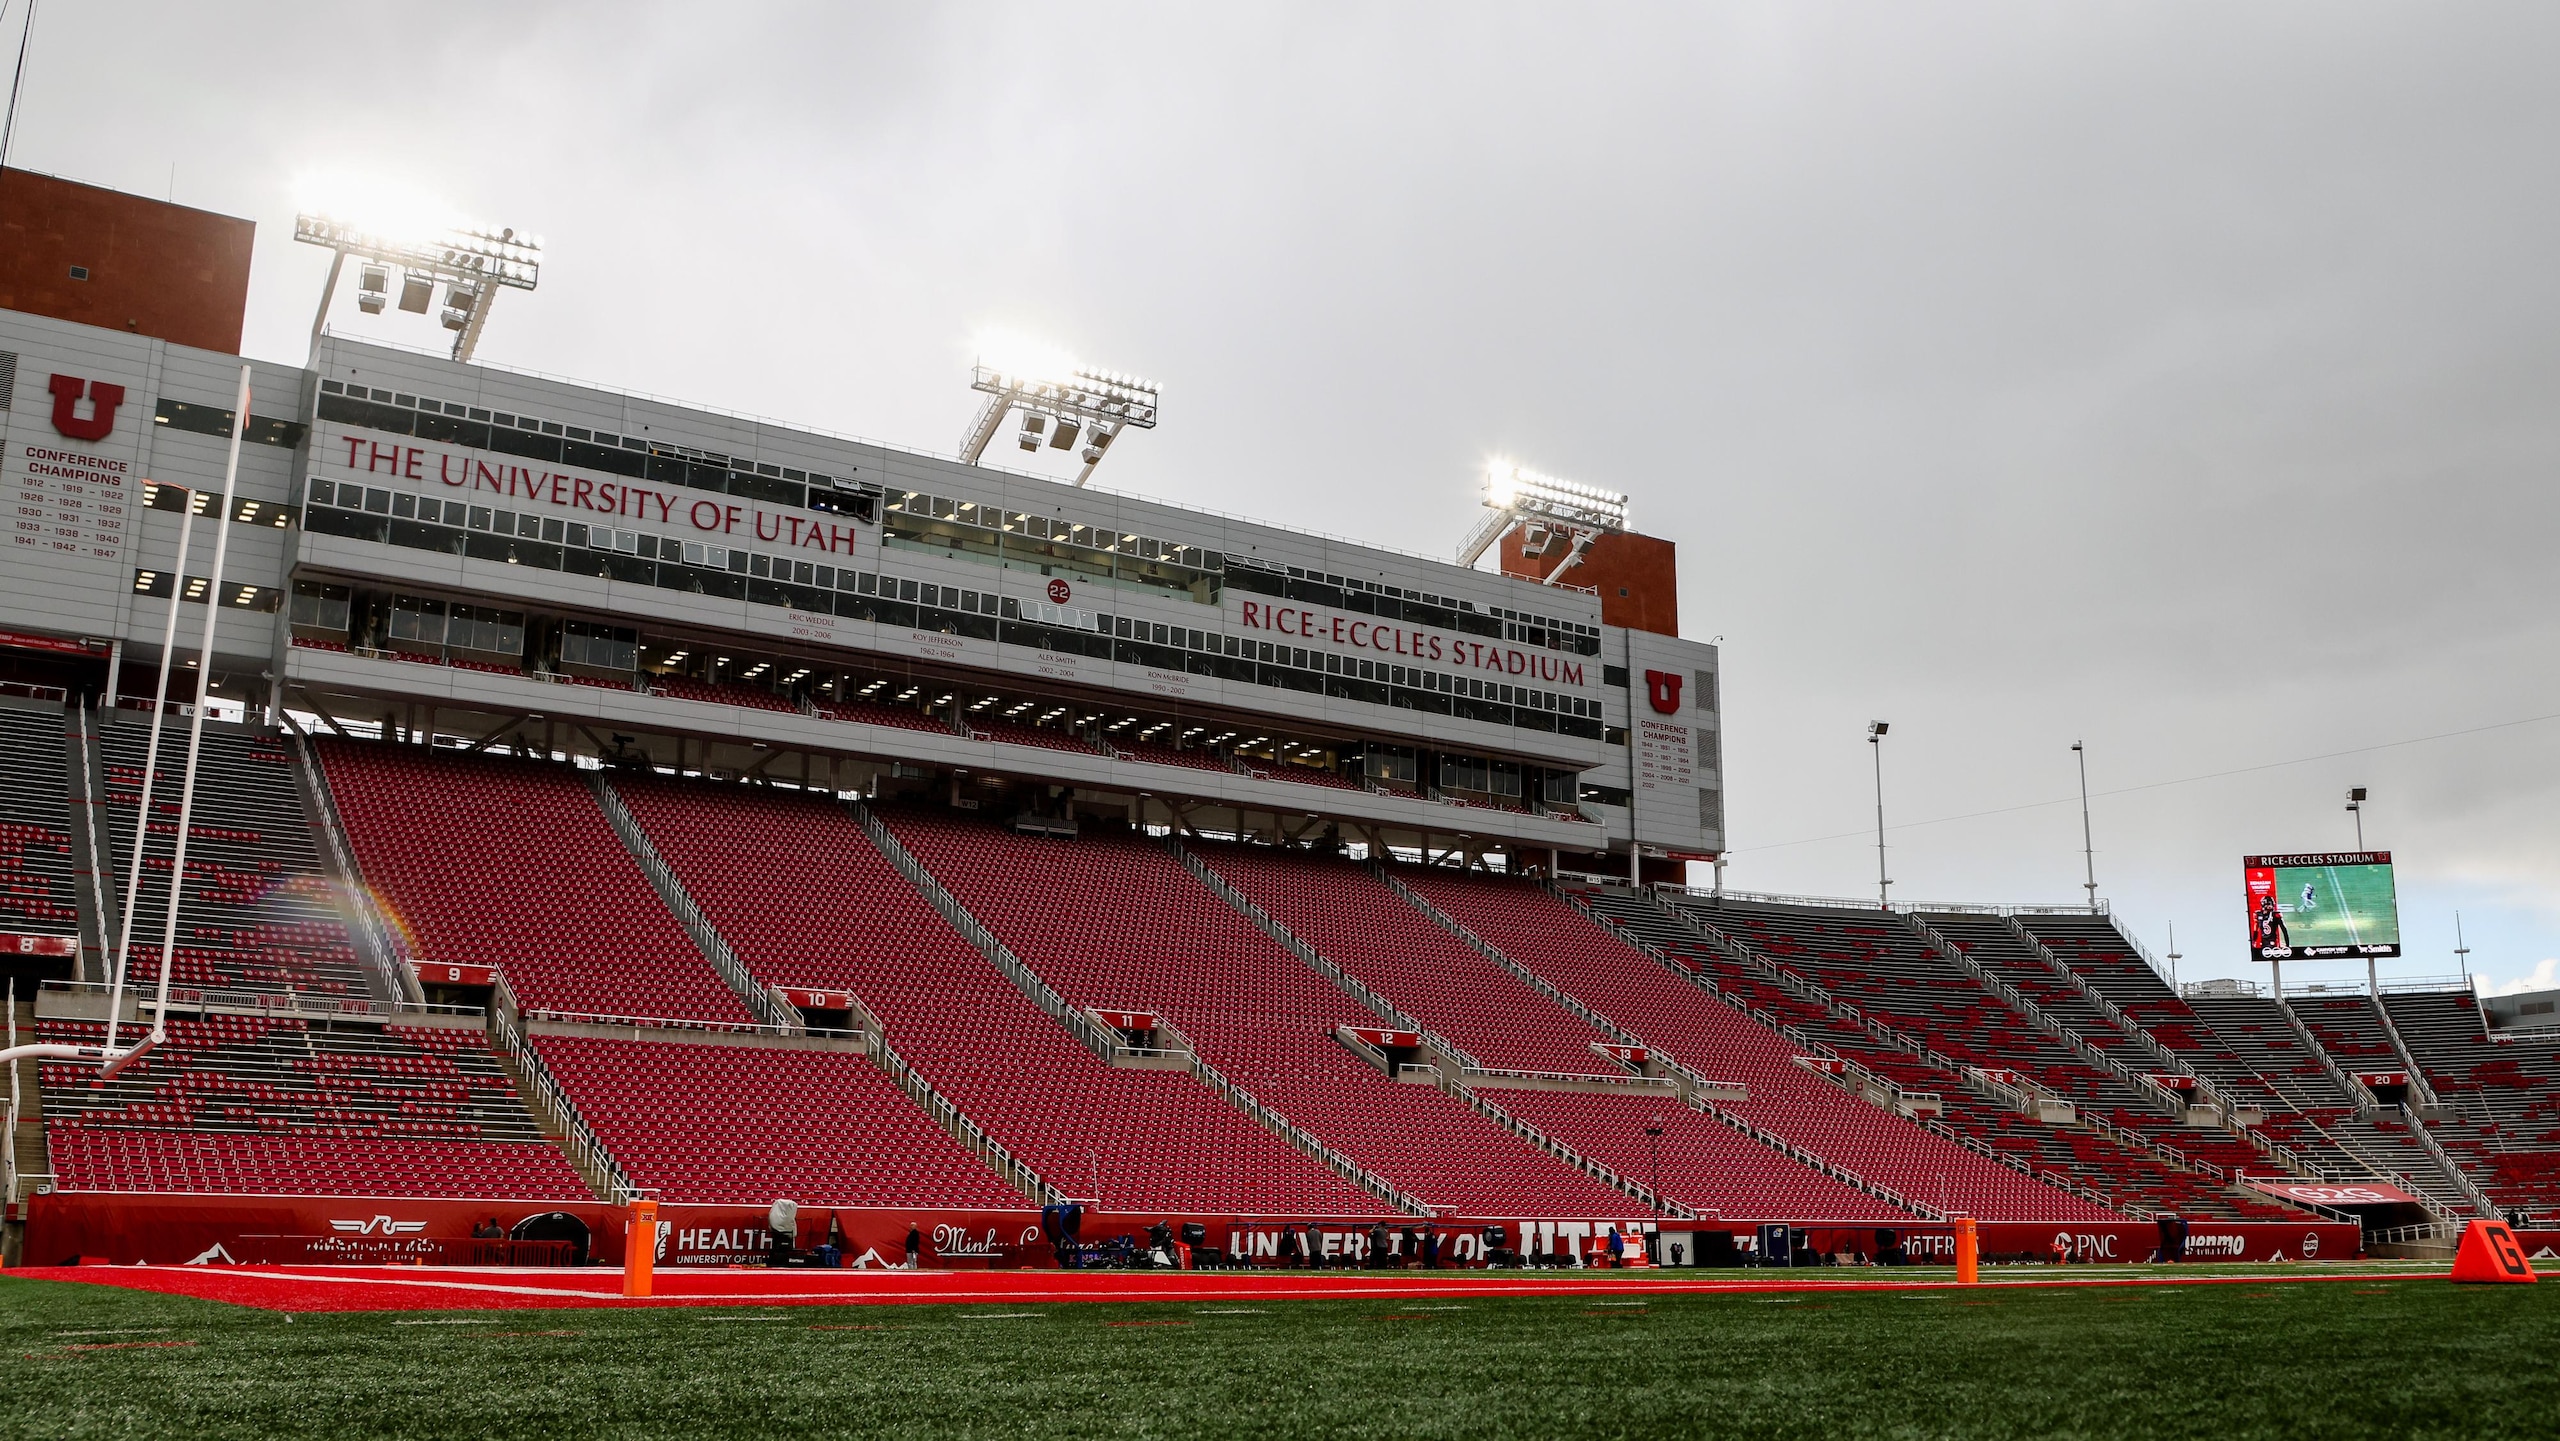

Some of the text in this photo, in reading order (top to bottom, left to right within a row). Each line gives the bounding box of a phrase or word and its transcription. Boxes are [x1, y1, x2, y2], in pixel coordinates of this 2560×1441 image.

[48, 373, 125, 441] U
[26, 446, 128, 473] CONFERENCE
[29, 462, 121, 486] CHAMPIONS
[23, 477, 44, 488] 1912
[62, 483, 83, 493] 1919
[100, 490, 124, 500] 1922
[343, 435, 856, 556] THE UNIVERSITY OF UTAH
[20, 492, 44, 502] 1926
[58, 498, 82, 508] 1928
[98, 504, 122, 515] 1929
[17, 506, 42, 517] 1930
[58, 513, 79, 523] 1931
[97, 519, 121, 529] 1932
[15, 521, 40, 532] 1933
[55, 527, 78, 538] 1938
[95, 533, 119, 544] 1940
[14, 536, 35, 545] 1941
[52, 541, 76, 552] 1942
[93, 548, 116, 558] 1947
[1050, 585, 1068, 599] 22
[789, 613, 835, 627] ERIC WEDDLE
[792, 627, 809, 636] 2003
[814, 630, 832, 639] 2006
[912, 633, 963, 647] ROY JEFFERSON
[1243, 601, 1584, 687] RICE-ECCLES STADIUM
[920, 647, 935, 655] 1962
[940, 650, 955, 659] 1964
[1037, 652, 1076, 666] ALEX SMITH
[1038, 665, 1053, 674] 2002
[1059, 669, 1074, 678] 2004
[1147, 671, 1189, 684] RON McBRIDE
[1152, 683, 1166, 692] 1990
[1170, 686, 1185, 695] 2002
[1645, 669, 1682, 715] U
[1640, 720, 1688, 735] CONFERENCE
[1643, 731, 1686, 744] CHAMPIONS
[1642, 781, 1655, 789] 2022
[961, 800, 977, 809] W12
[2261, 853, 2374, 865] RICE-ECCLES STADIUM
[2263, 920, 2272, 935] 5
[20, 938, 34, 952] 8
[449, 967, 461, 982] 9
[808, 993, 826, 1007] 10
[1122, 1015, 1133, 1027] 11
[1380, 1033, 1393, 1044] 12
[1619, 1049, 1631, 1059] 13
[1820, 1062, 1831, 1072] 14
[1994, 1073, 2004, 1082] 15
[2169, 1078, 2180, 1088] 17
[2375, 1077, 2390, 1085] 20
[2288, 1187, 2385, 1199] G2G
[677, 1228, 773, 1251] HEALTH
[932, 1224, 1009, 1253] Mink
[2076, 1235, 2118, 1258] PNC
[2485, 1226, 2527, 1274] G
[676, 1254, 732, 1264] UNIVERSITY
[734, 1255, 748, 1263] OF
[1592, 1258, 1599, 1267] G
